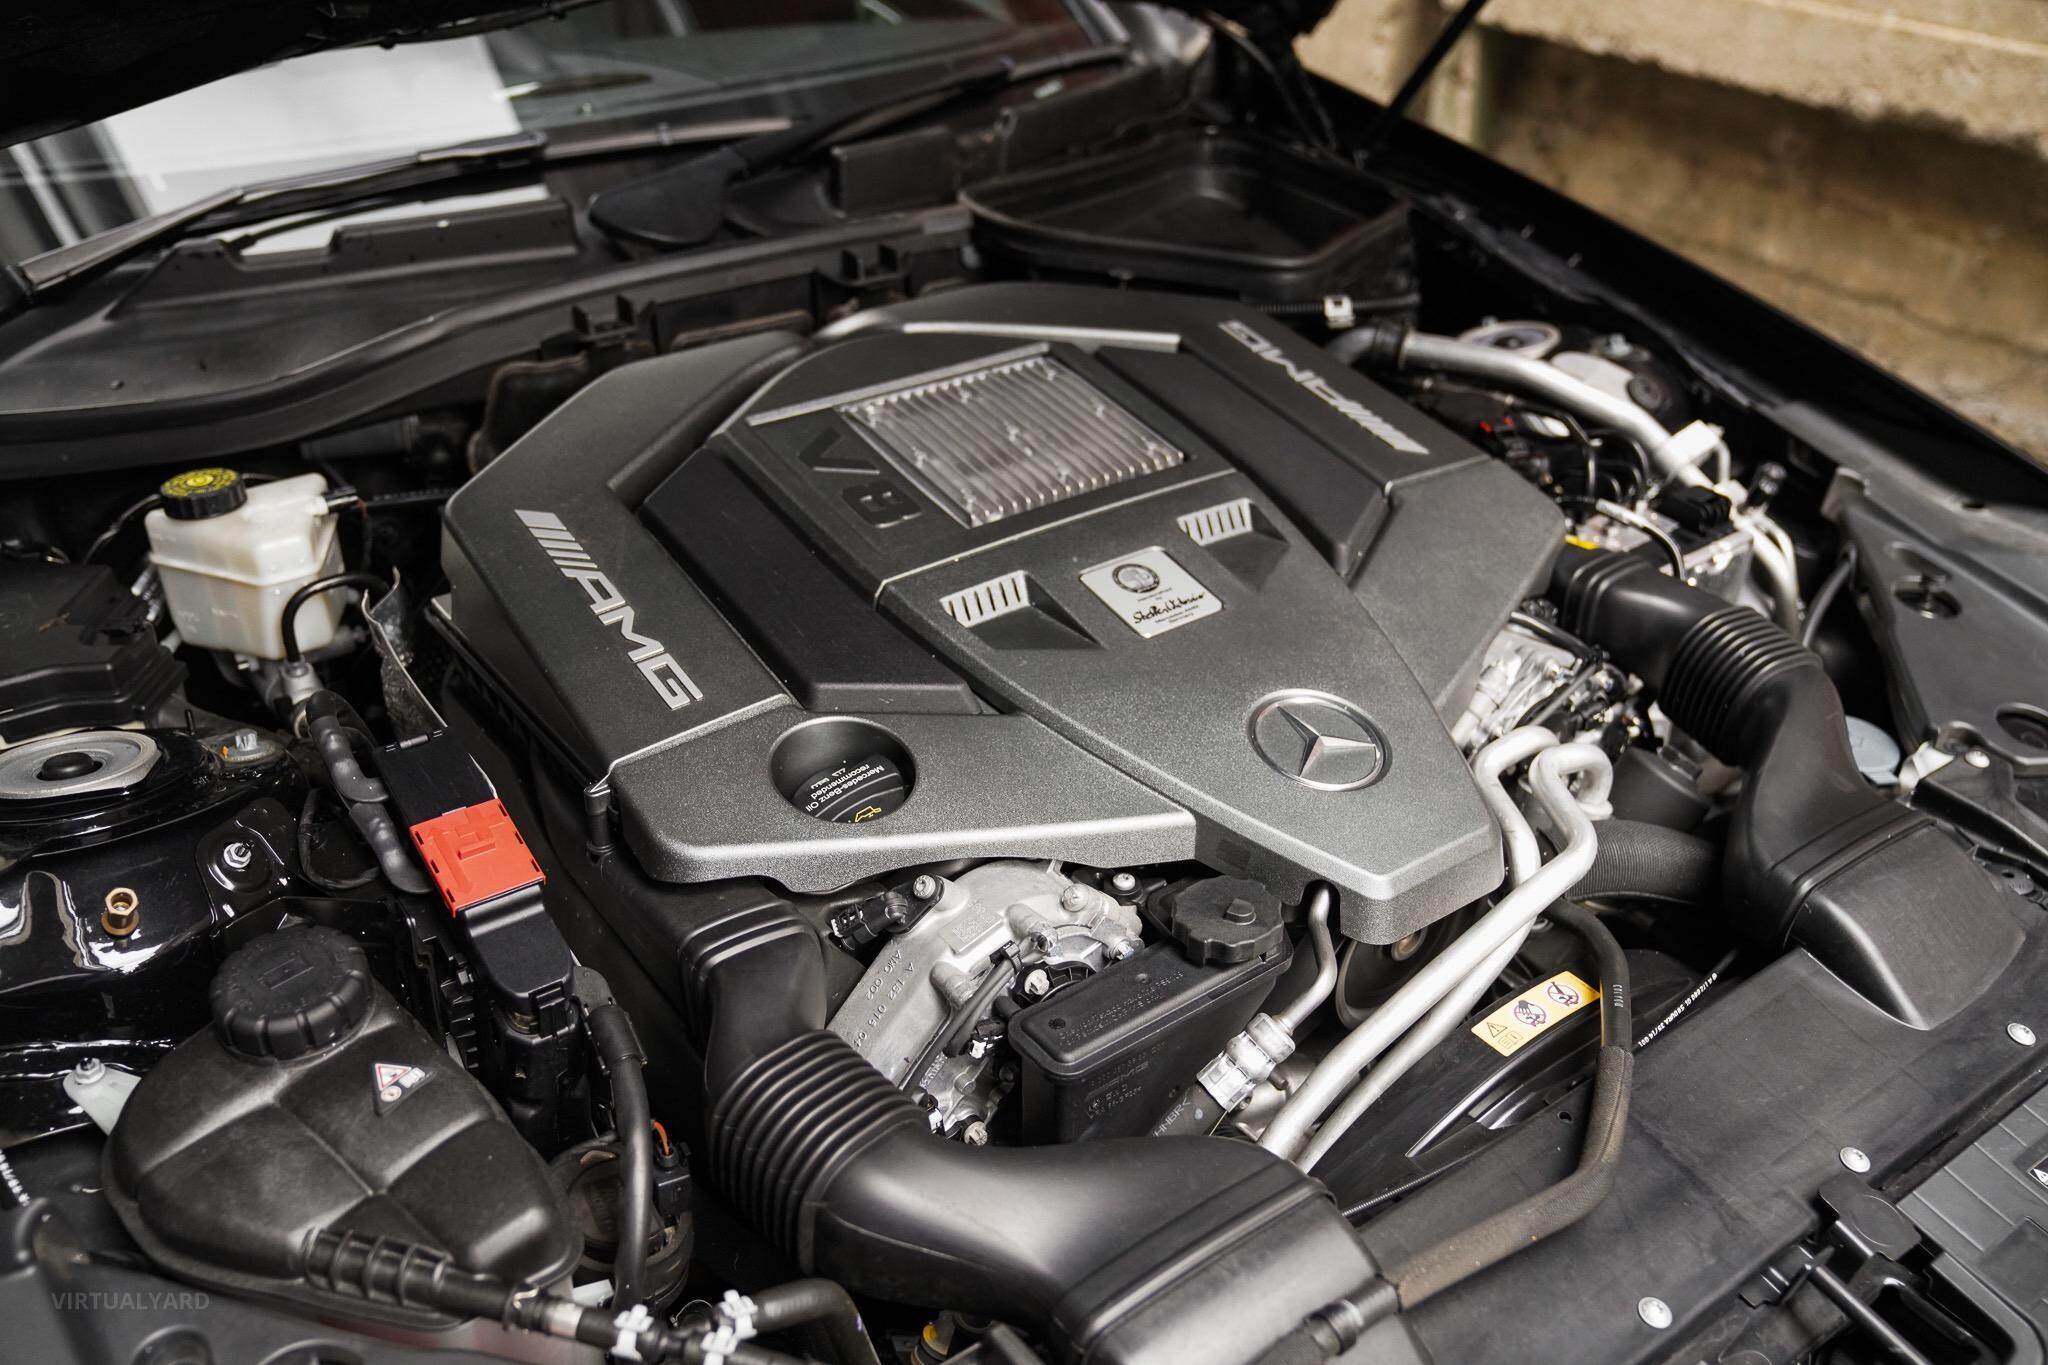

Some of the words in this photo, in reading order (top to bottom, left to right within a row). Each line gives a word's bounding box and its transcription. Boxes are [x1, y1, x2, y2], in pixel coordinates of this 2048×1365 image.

[798, 427, 922, 528] V8
[558, 566, 704, 711] AMG
[811, 764, 870, 800] recommended
[819, 765, 885, 803] Mercedes-Benz
[805, 801, 819, 812] Oil
[883, 949, 902, 975] AMG
[905, 962, 914, 973] A
[865, 978, 883, 1001] 002
